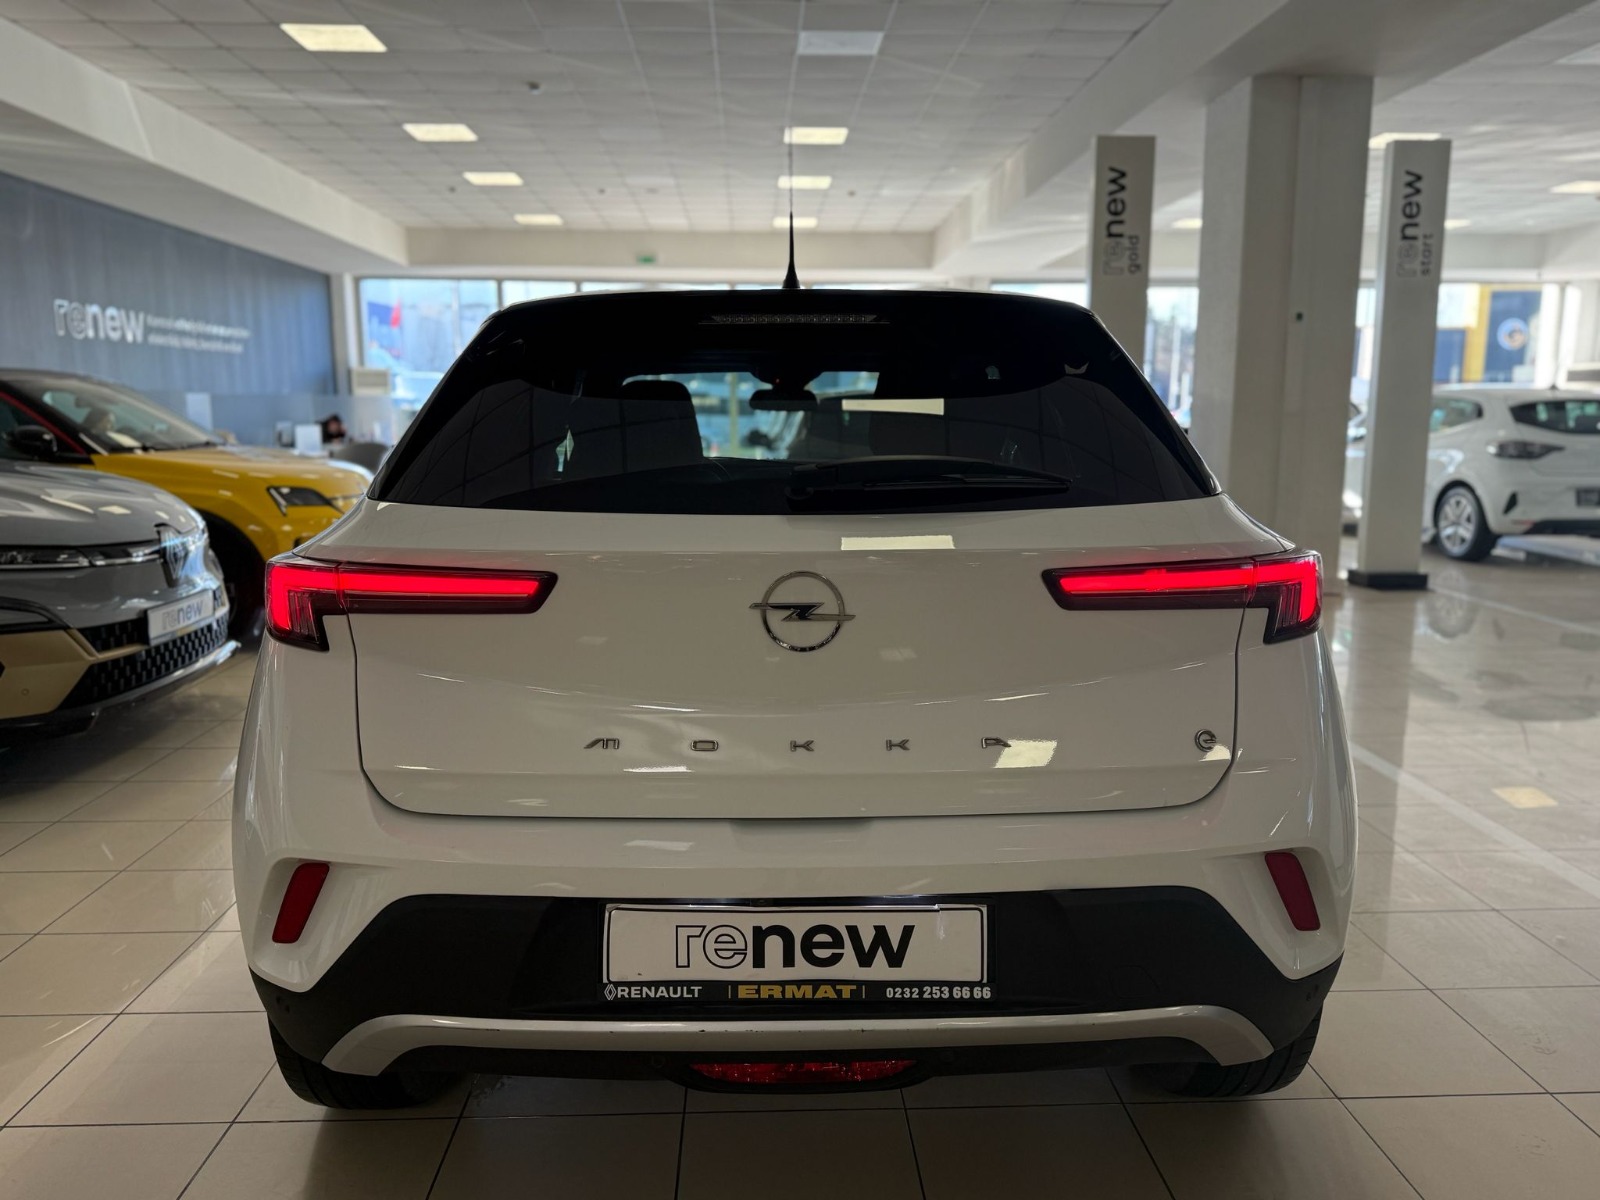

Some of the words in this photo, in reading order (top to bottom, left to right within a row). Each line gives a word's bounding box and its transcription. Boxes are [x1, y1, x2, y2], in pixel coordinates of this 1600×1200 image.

[1124, 235, 1141, 275] gold
[1421, 233, 1434, 276] start
[53, 298, 145, 344] renew
[675, 924, 915, 969] renew
[617, 986, 702, 998] RENAULT
[738, 985, 857, 999] ERMAT
[886, 987, 919, 999] 0232
[923, 986, 950, 999] 253
[953, 986, 970, 999] 66
[973, 986, 991, 999] 66
